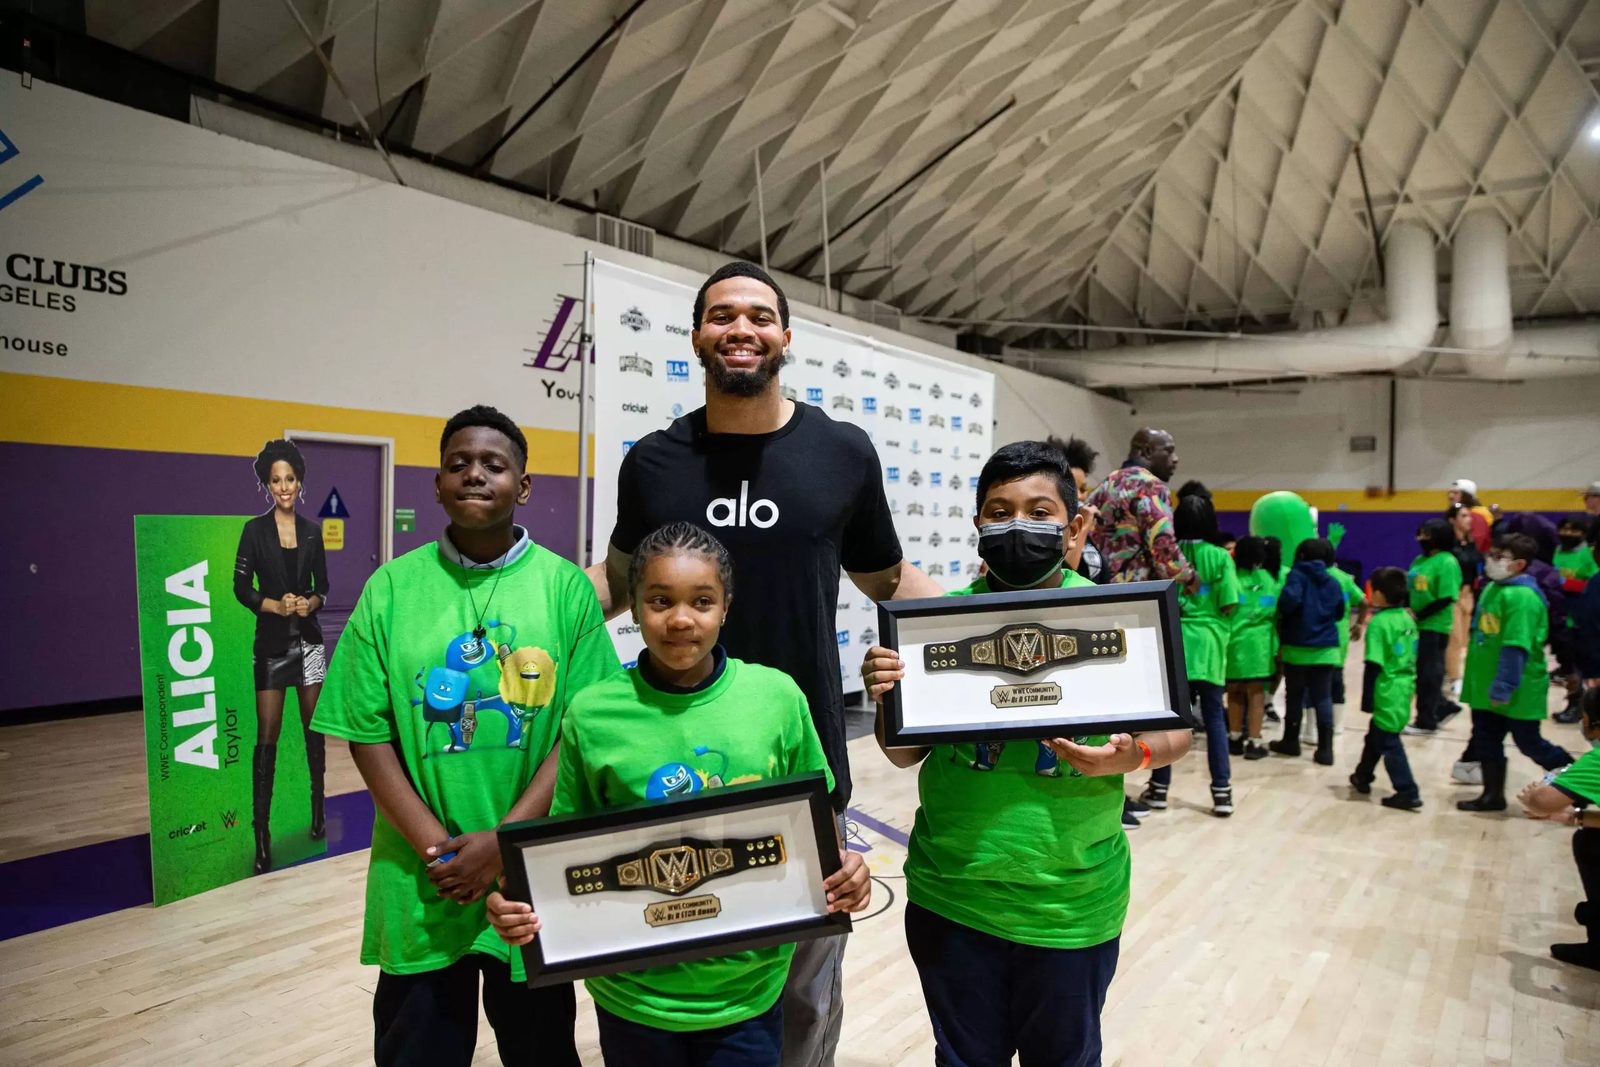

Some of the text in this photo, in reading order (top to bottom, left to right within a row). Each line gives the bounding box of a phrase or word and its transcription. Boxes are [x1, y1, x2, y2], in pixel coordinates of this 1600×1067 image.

[6, 254, 127, 295] CLUBS
[622, 402, 648, 414] cricket
[706, 480, 780, 529] alo
[165, 559, 220, 770] ALICIA
[156, 674, 170, 781] WWE Correspondent
[224, 707, 242, 768] Taylor
[168, 821, 208, 839] cricket
